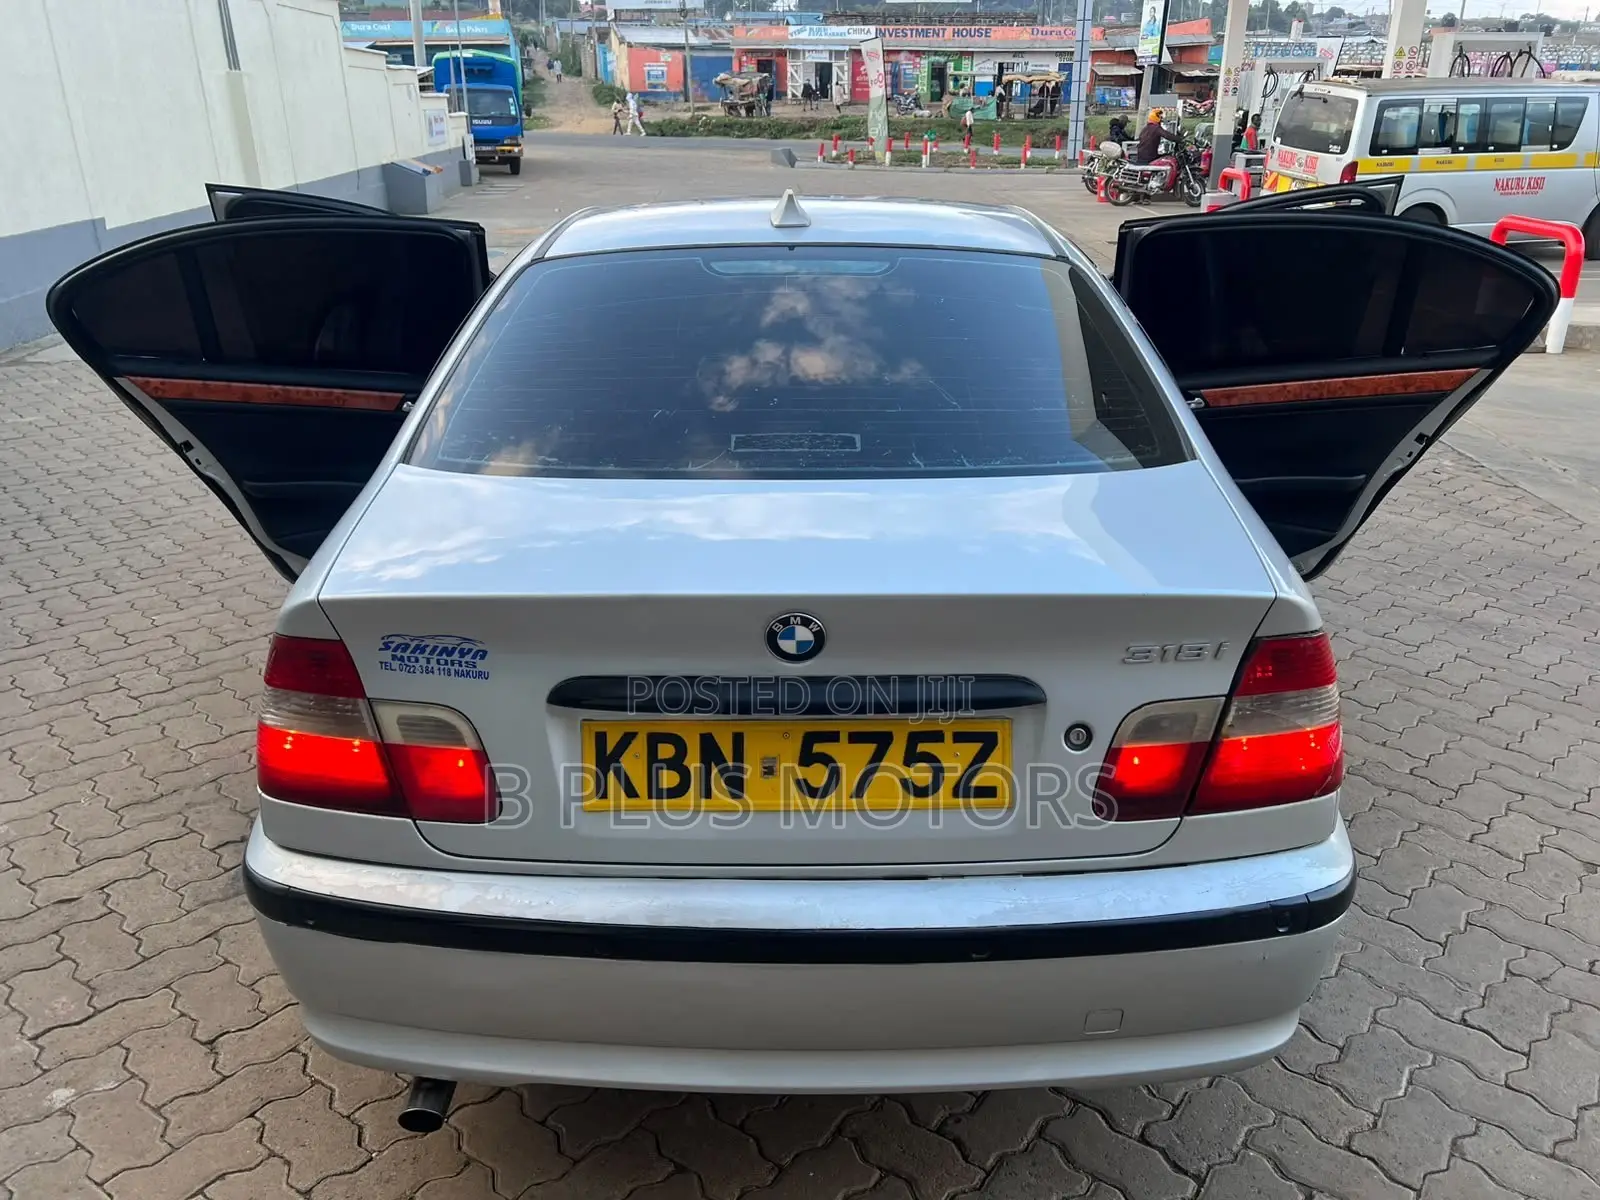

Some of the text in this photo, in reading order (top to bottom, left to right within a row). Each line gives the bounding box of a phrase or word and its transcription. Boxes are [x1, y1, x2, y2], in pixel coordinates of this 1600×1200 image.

[875, 27, 947, 38] INVESTMENT
[952, 27, 992, 38] HOUSE
[1031, 27, 1077, 36] Dura Co
[1494, 176, 1546, 191] NAKURU KISII
[771, 616, 820, 633] BMW
[378, 641, 488, 661] SAKINYA
[1122, 641, 1230, 664] 318i
[391, 654, 477, 668] MOTORS
[438, 666, 452, 677] 118
[453, 668, 490, 680] NAKURU
[594, 730, 999, 800] KBN 575Z
